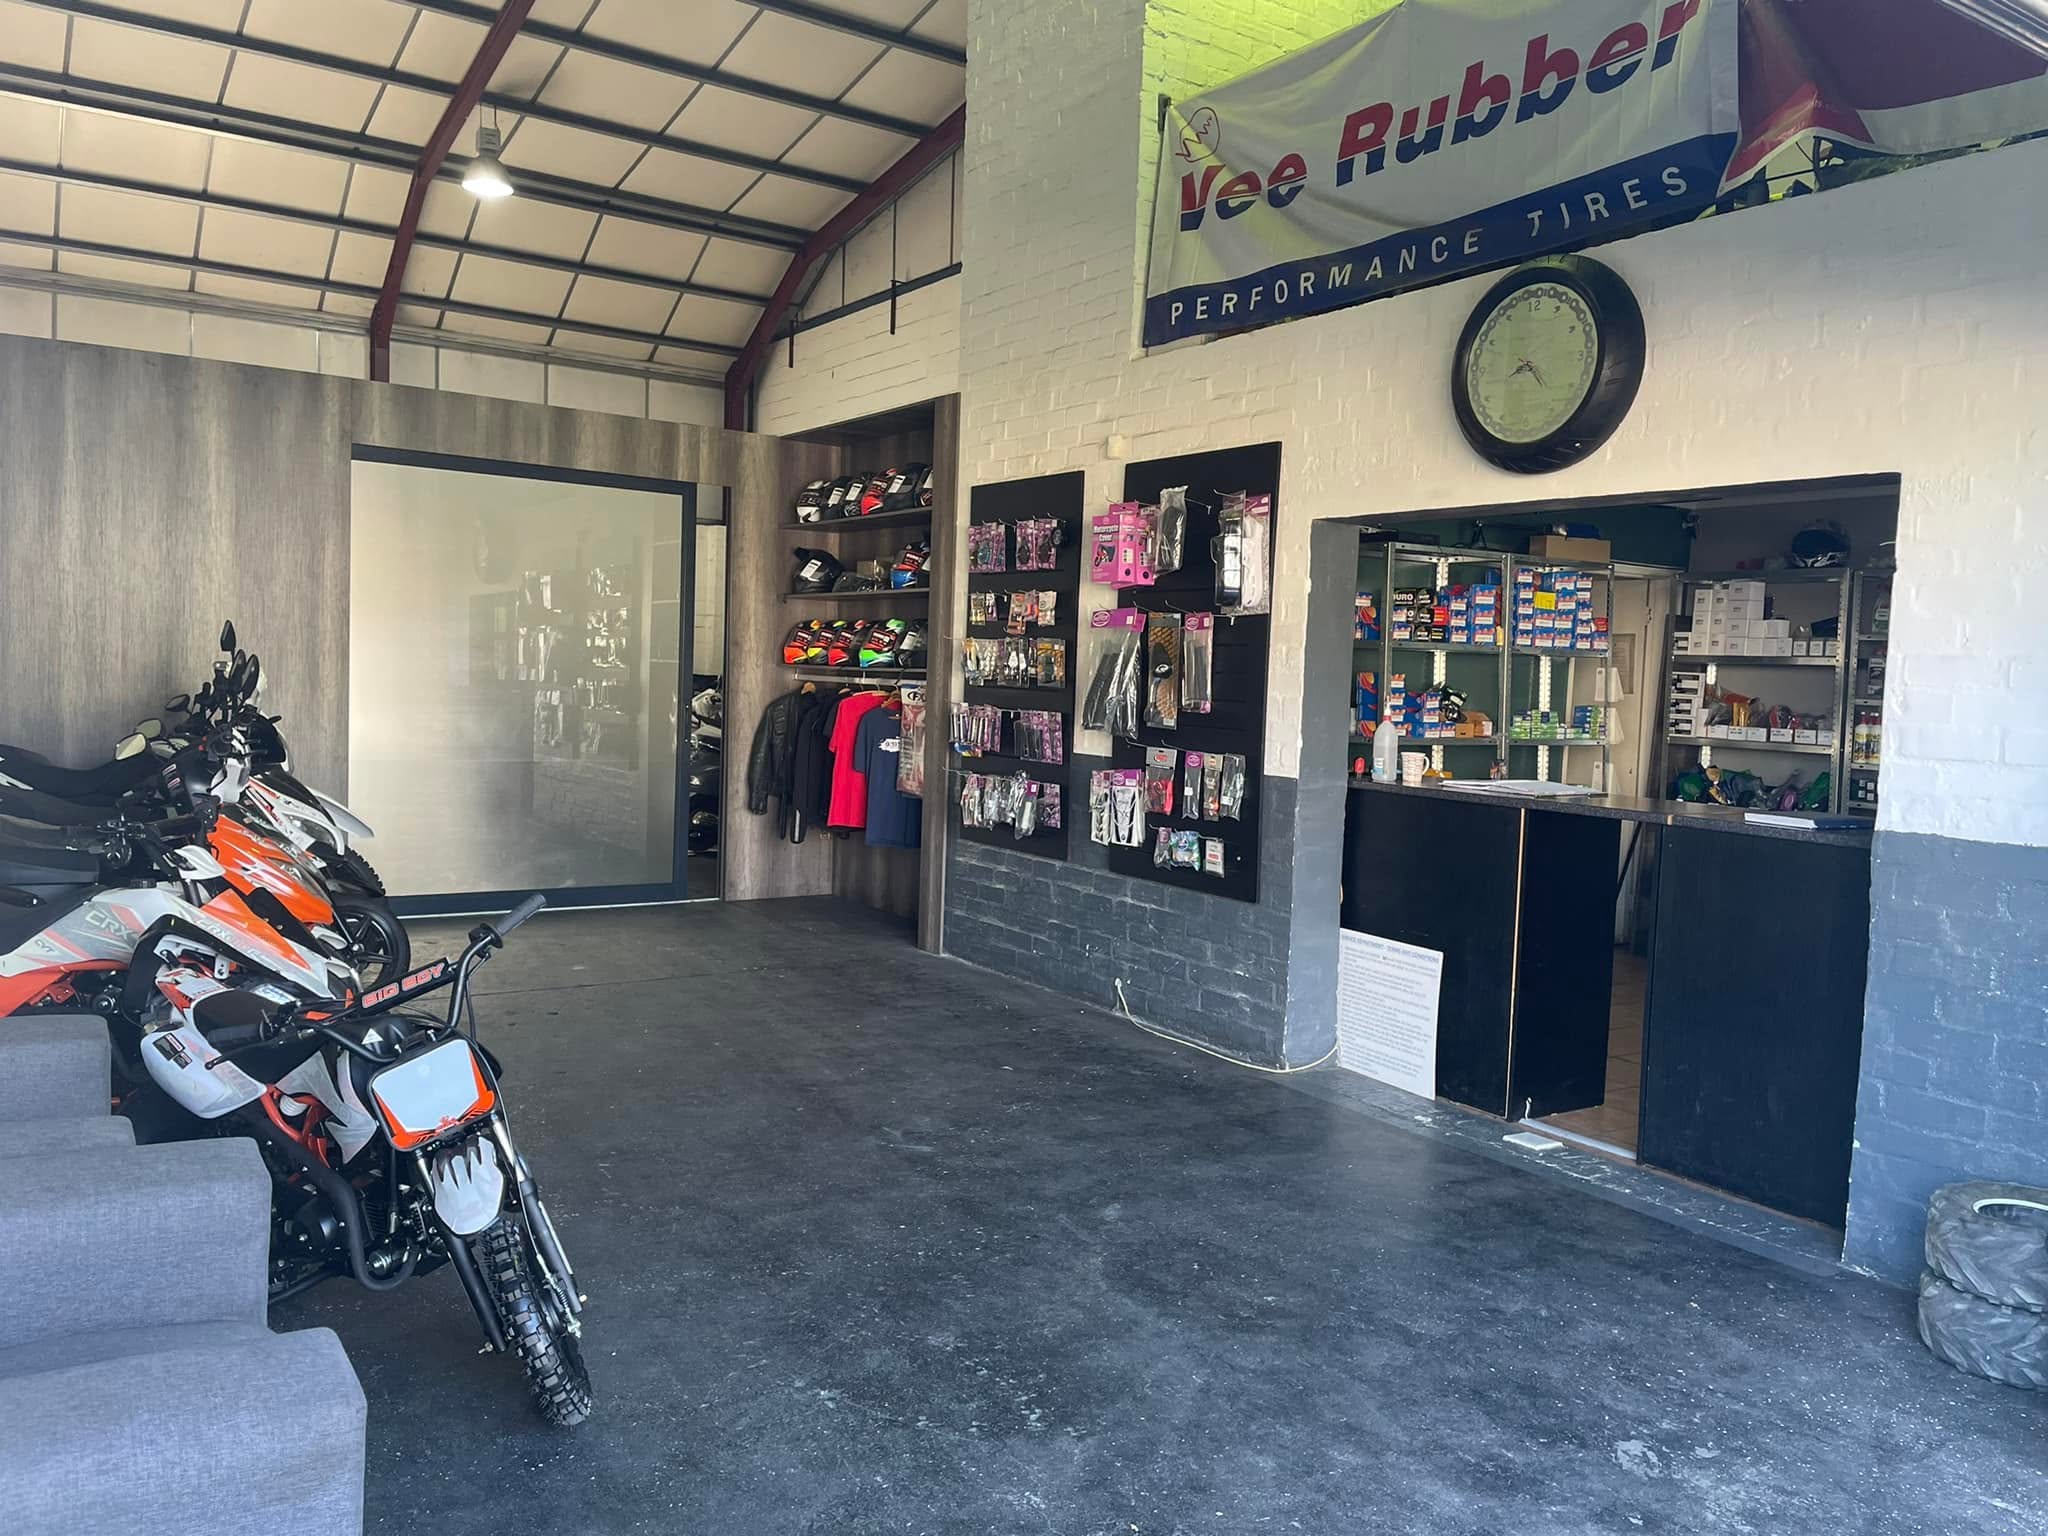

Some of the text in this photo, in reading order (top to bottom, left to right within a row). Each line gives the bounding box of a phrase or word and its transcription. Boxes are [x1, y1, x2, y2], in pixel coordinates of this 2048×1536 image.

[1179, 0, 1700, 232] Vee Rubber
[1171, 166, 1688, 325] PERFORMANCE TIRES
[1527, 301, 1541, 312] 12
[362, 962, 445, 1009] BIG BOY
